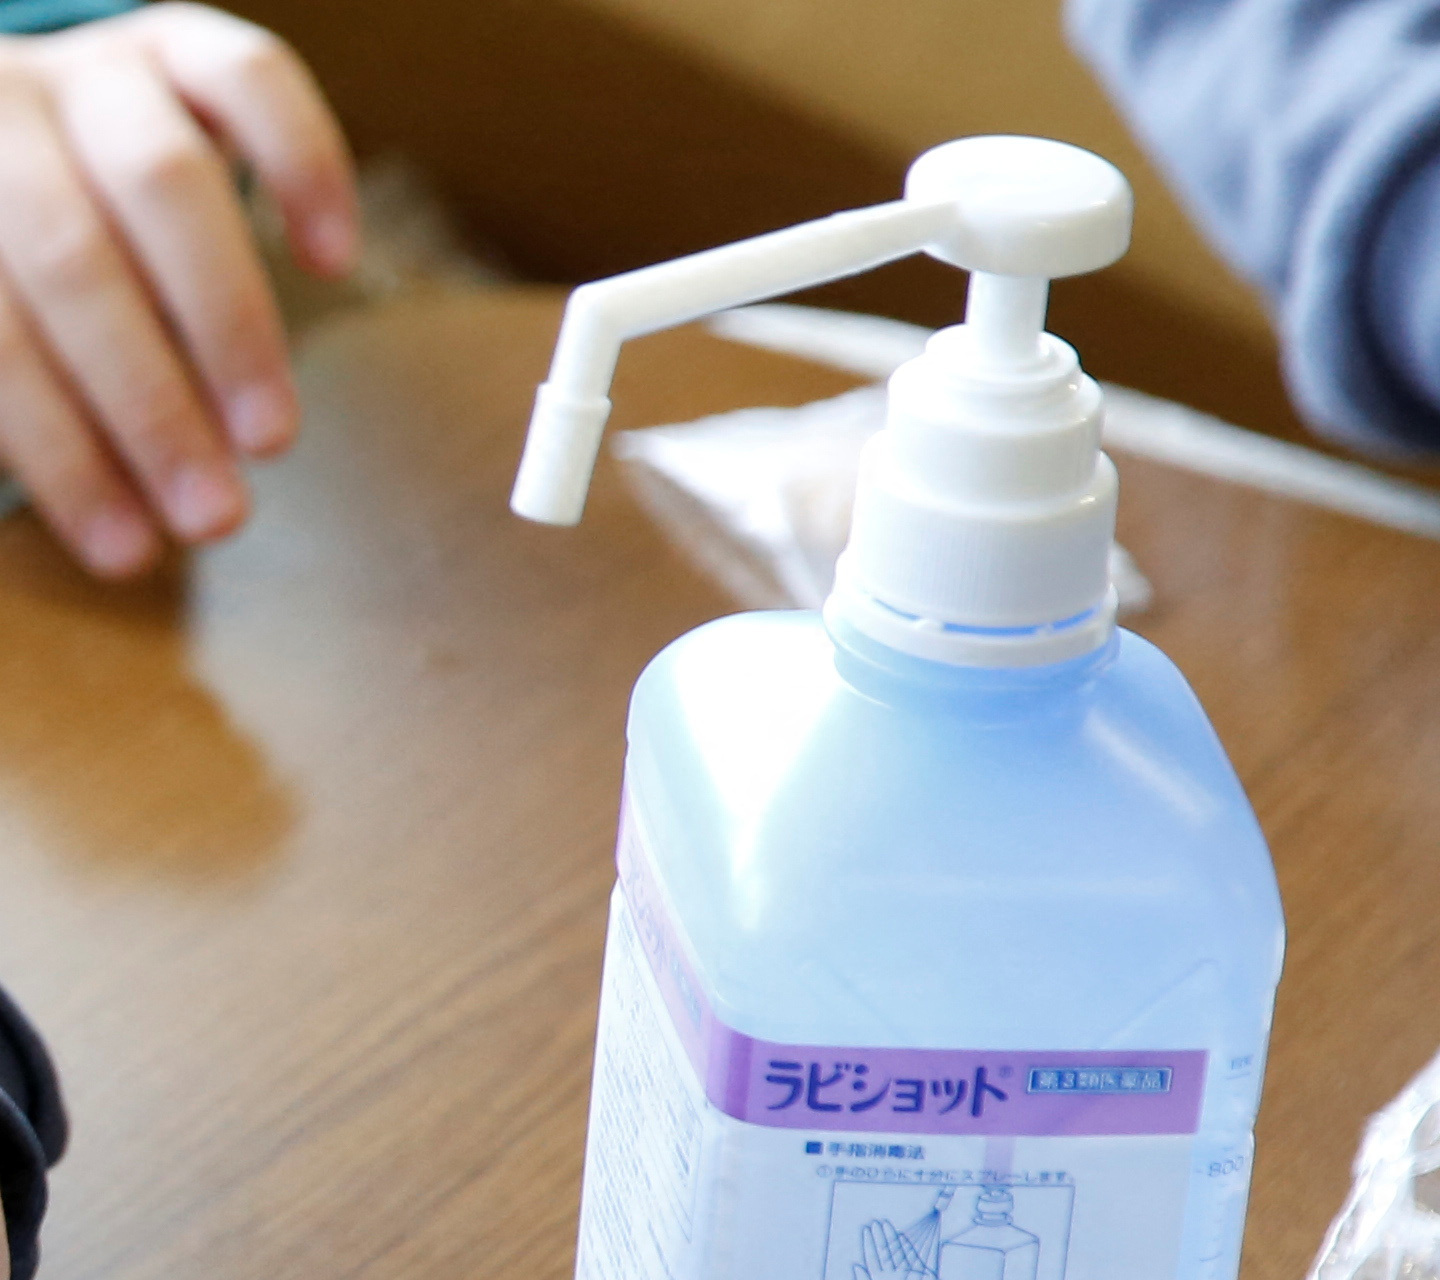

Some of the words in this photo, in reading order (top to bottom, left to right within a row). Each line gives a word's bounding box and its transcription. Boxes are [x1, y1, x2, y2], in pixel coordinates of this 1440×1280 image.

[765, 1060, 1008, 1117] ラビショット
